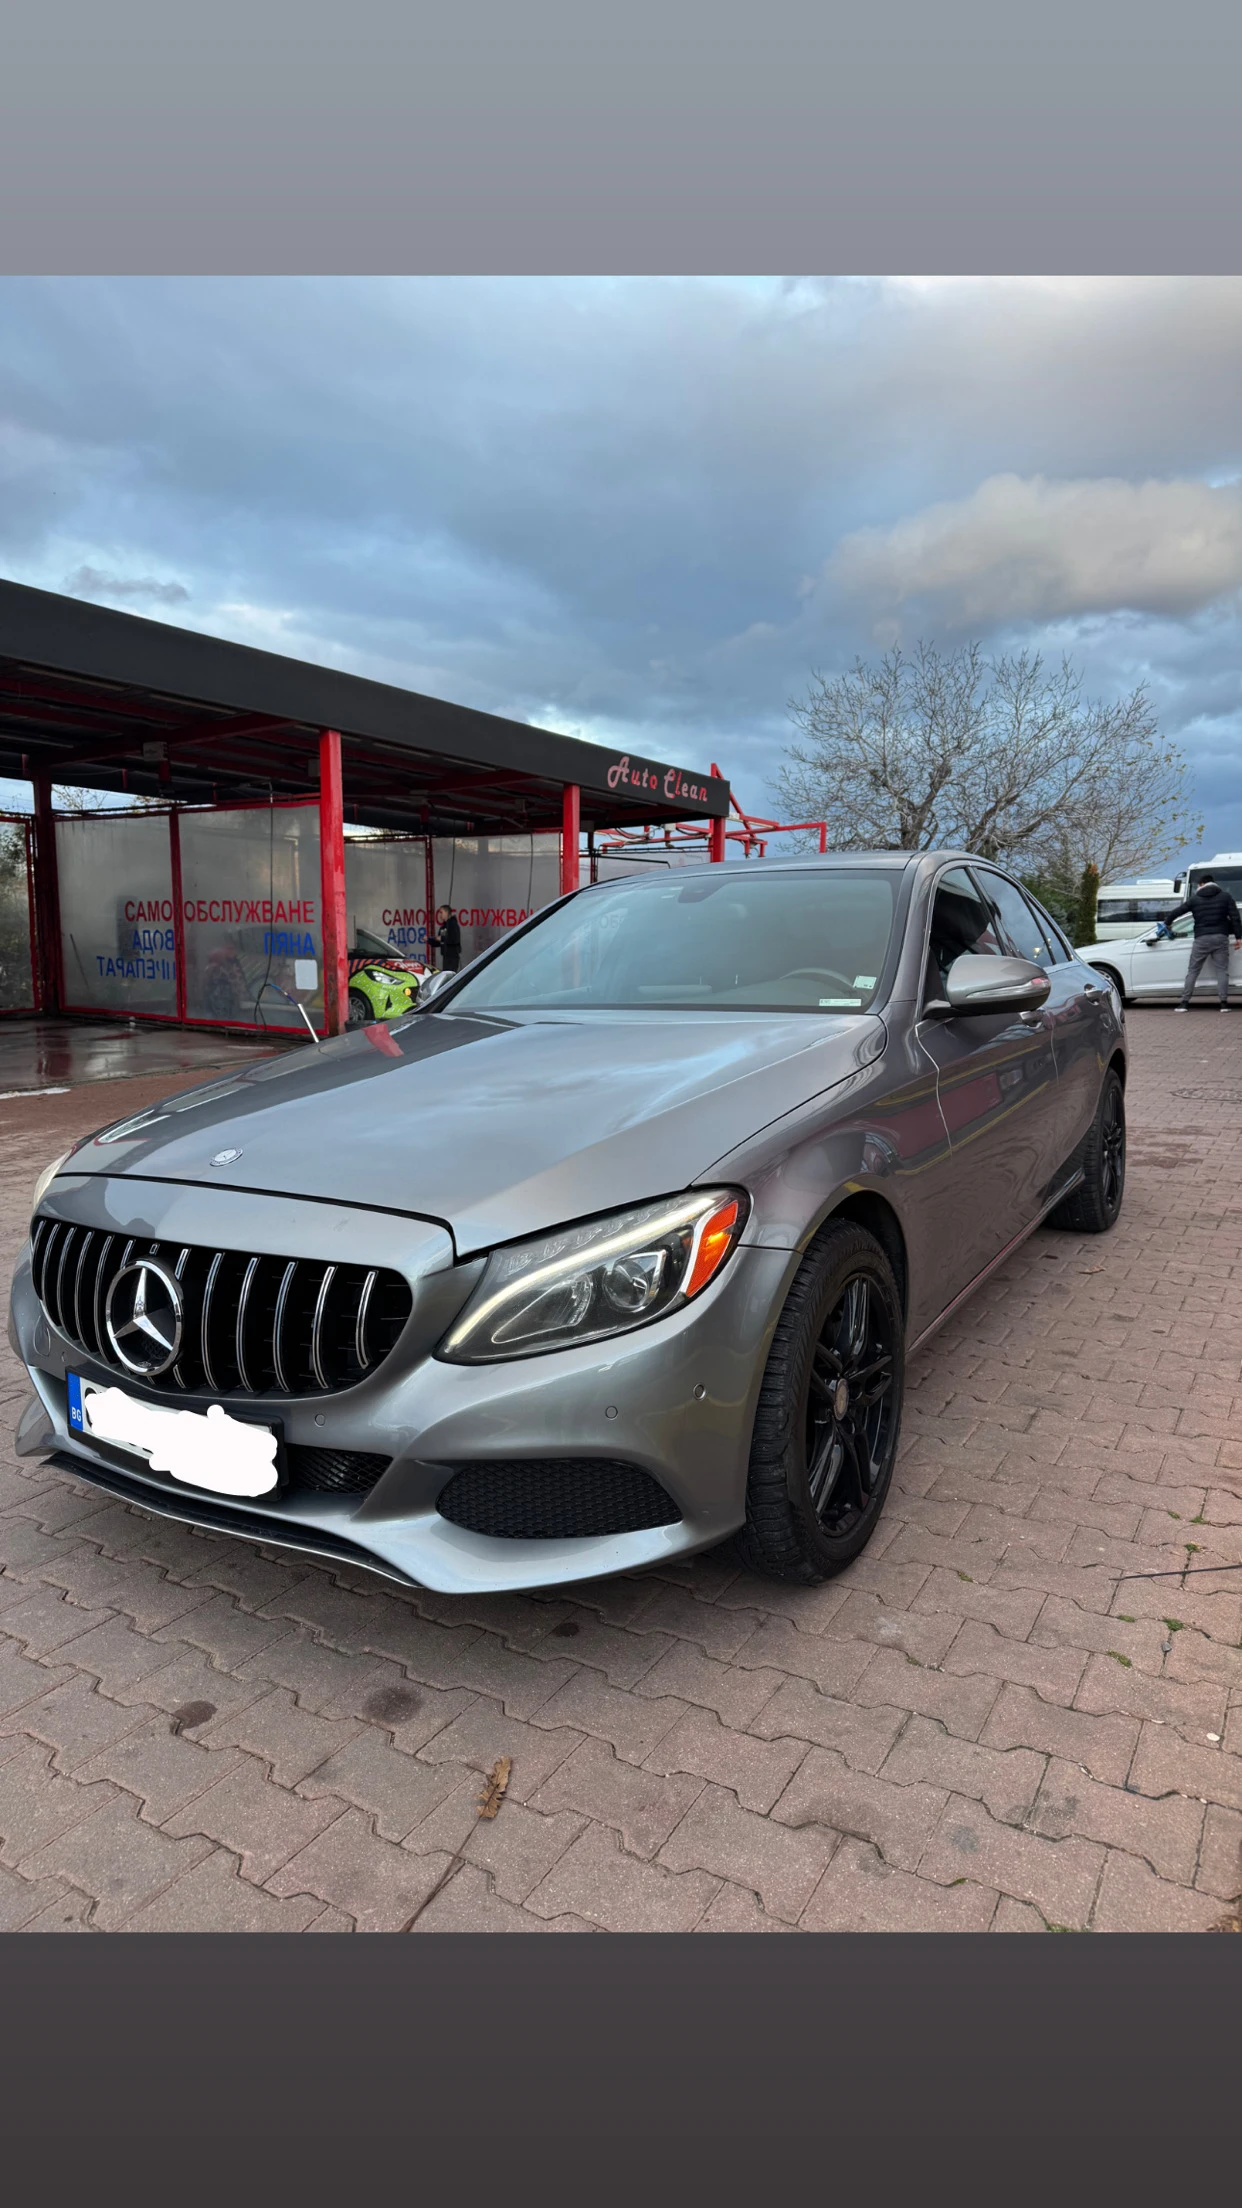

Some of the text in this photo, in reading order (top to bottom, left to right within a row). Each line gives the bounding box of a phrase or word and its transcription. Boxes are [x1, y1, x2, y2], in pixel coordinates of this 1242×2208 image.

[608, 756, 708, 802] Auto Clean
[71, 1406, 82, 1422] BG
